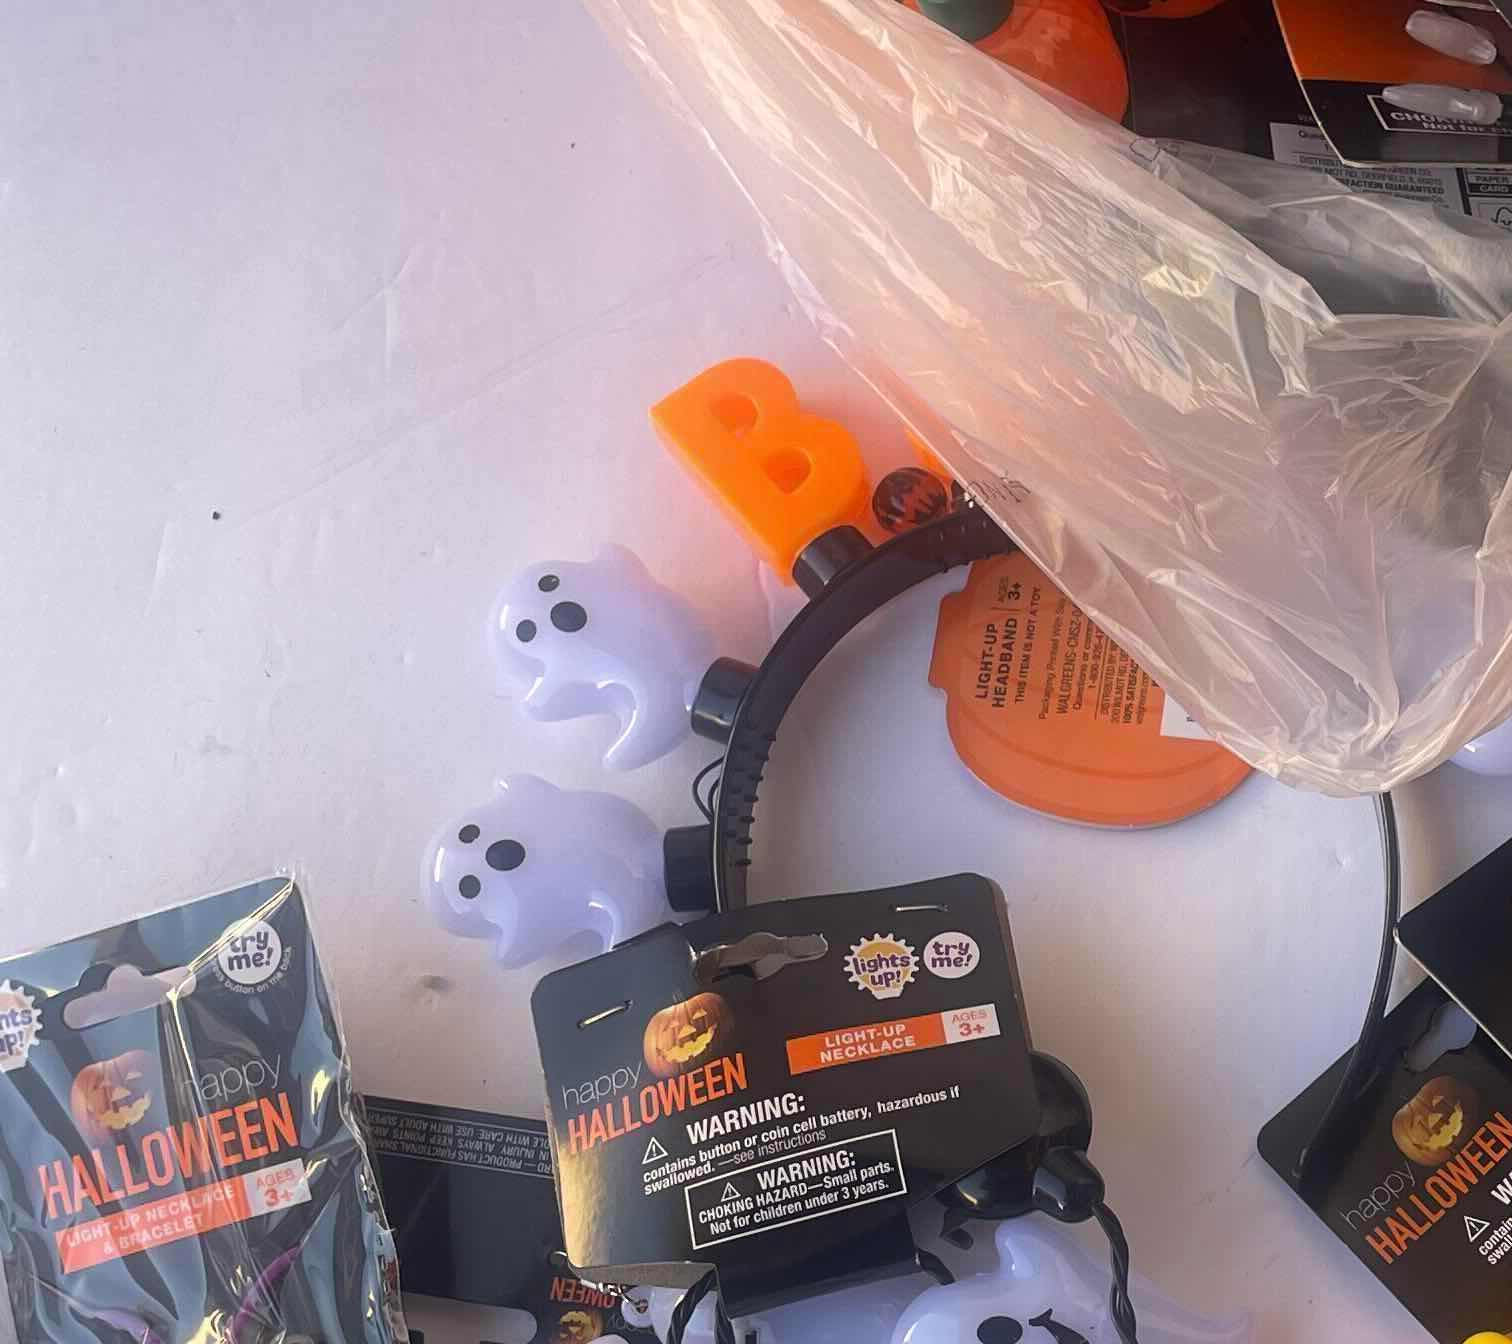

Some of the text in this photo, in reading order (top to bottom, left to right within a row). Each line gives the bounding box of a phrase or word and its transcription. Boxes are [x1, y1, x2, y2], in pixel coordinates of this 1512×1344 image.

[1007, 581, 1022, 601] 3+
[975, 623, 999, 699] LIGHT-UP
[991, 617, 1018, 708] HEADBAND
[1014, 607, 1039, 705] THIS ITEM A
[225, 943, 277, 975] me!
[850, 947, 914, 981] lights
[929, 947, 975, 972] me!
[932, 941, 972, 959] try
[868, 967, 904, 990] up!
[824, 1023, 906, 1050] LIGHT-UP
[957, 1019, 987, 1039] 3+
[820, 1035, 916, 1064] NECKLACE
[562, 1064, 641, 1109] happy
[568, 1054, 751, 1154] HALLOWEEN
[643, 1090, 948, 1183] contains button coin hazardous
[686, 1093, 805, 1144] WARNING:
[39, 1095, 298, 1218] HALLOWEEN
[457, 1138, 497, 1153] ALWAYS
[505, 1133, 530, 1148] WITH
[477, 1153, 523, 1170] PRODUCT
[643, 1129, 827, 1196] swallowed. instructions
[757, 1150, 856, 1190] WARNING:
[262, 1183, 293, 1209] 3+
[698, 1161, 895, 1224] CHOKING parts.
[753, 1179, 889, 1223] children under years.
[1336, 1156, 1420, 1234] happy
[66, 1184, 237, 1248] LIGHT-UP NECKLACE
[119, 1211, 208, 1251] BRACELET
